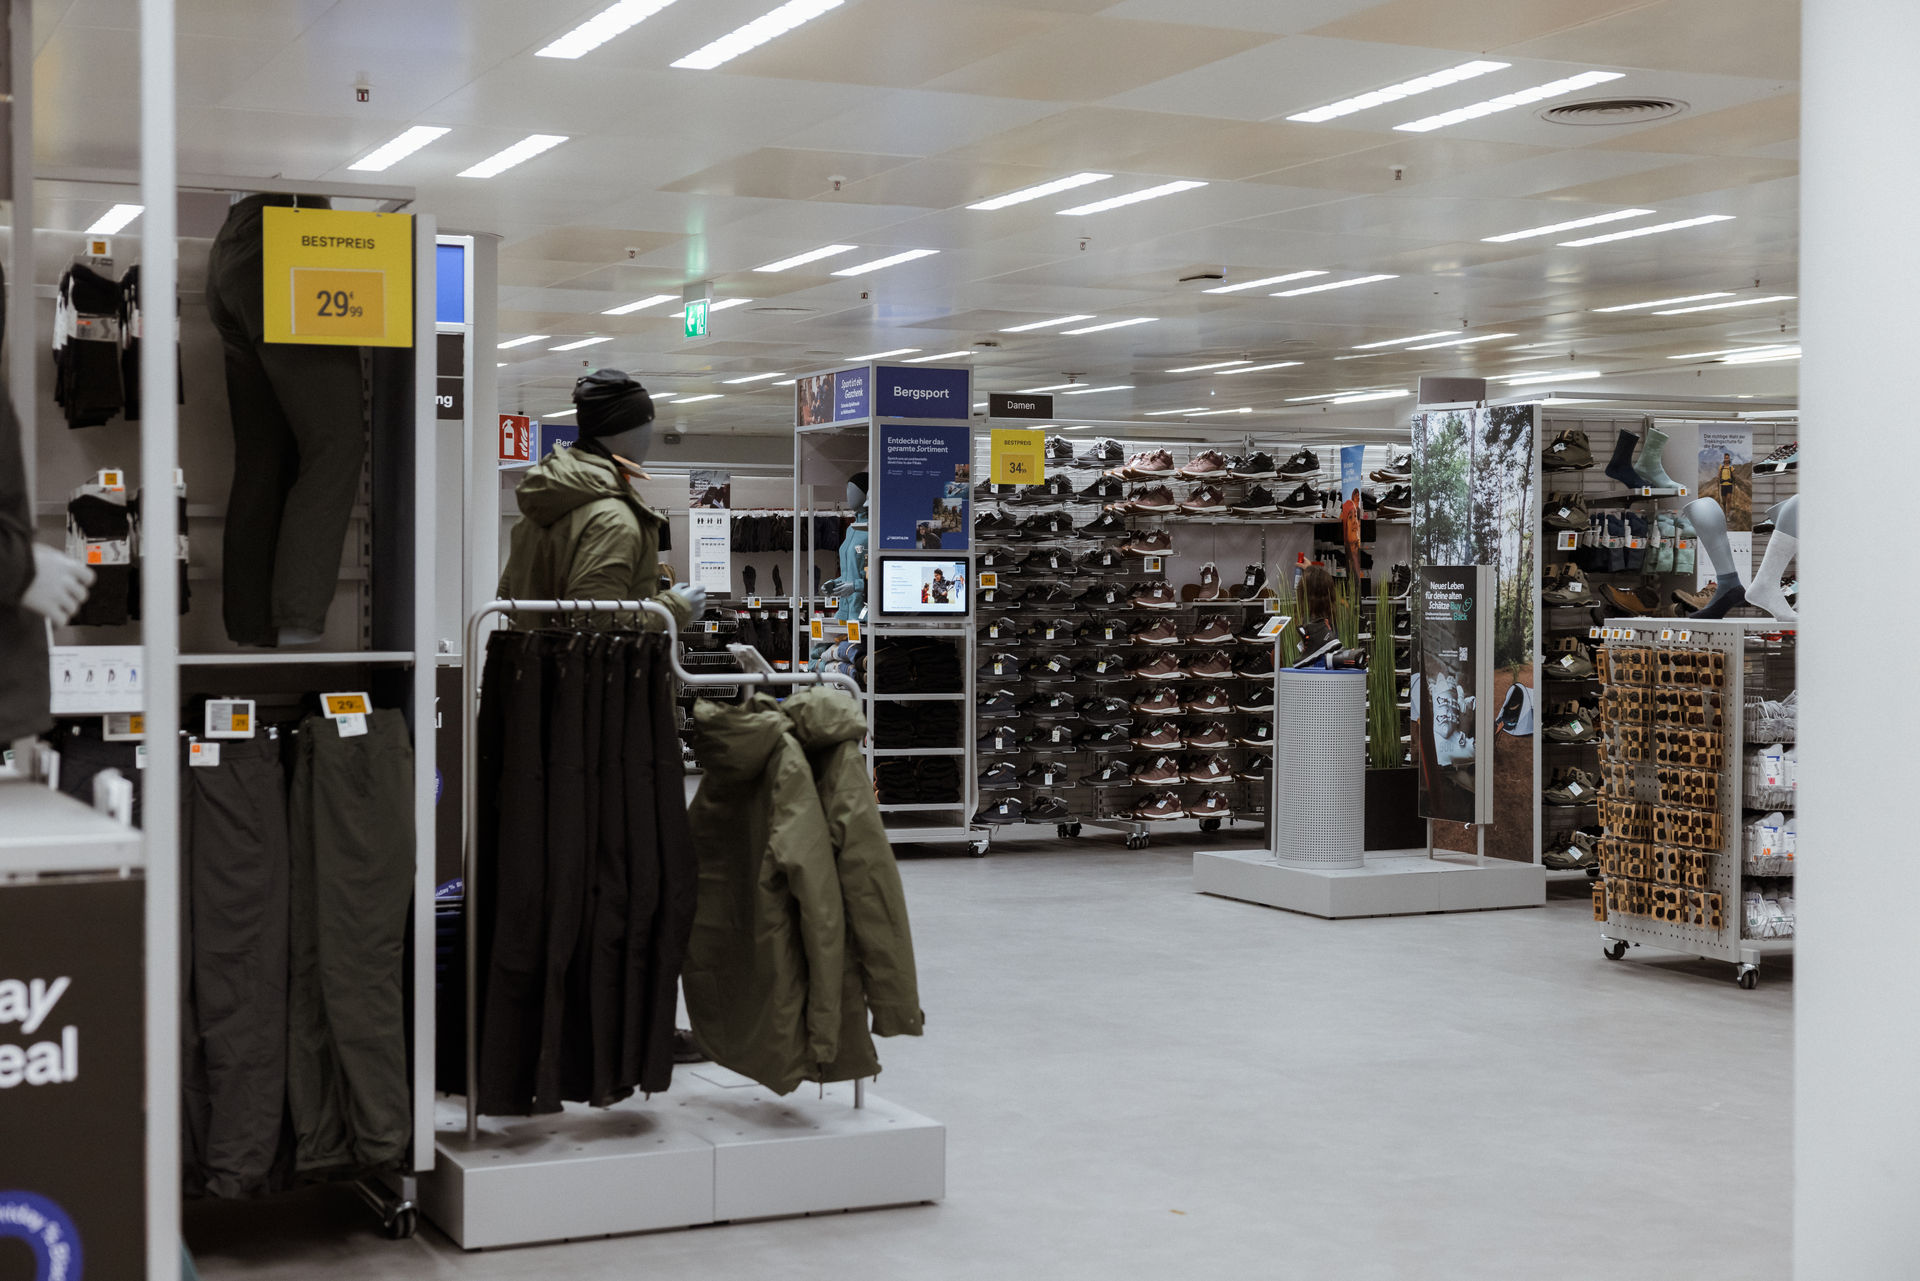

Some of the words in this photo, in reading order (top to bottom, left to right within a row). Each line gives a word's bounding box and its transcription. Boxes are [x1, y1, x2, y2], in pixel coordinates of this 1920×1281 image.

[301, 235, 375, 249] BESTPREIS
[893, 386, 950, 400] Bergsport
[1007, 400, 1036, 410] Damen
[887, 436, 919, 445] Entdecke
[919, 437, 932, 445] hier
[932, 438, 945, 446] das
[916, 445, 949, 453] Sortiment
[1447, 581, 1465, 590] Leben
[1425, 591, 1433, 599] für
[1433, 591, 1448, 600] deine
[1448, 592, 1463, 600] alten
[1428, 601, 1450, 610] Schätze
[1450, 601, 1461, 611] Buy
[1453, 612, 1468, 621] Back
[0, 975, 72, 1035] ay
[0, 1024, 78, 1088] eal
